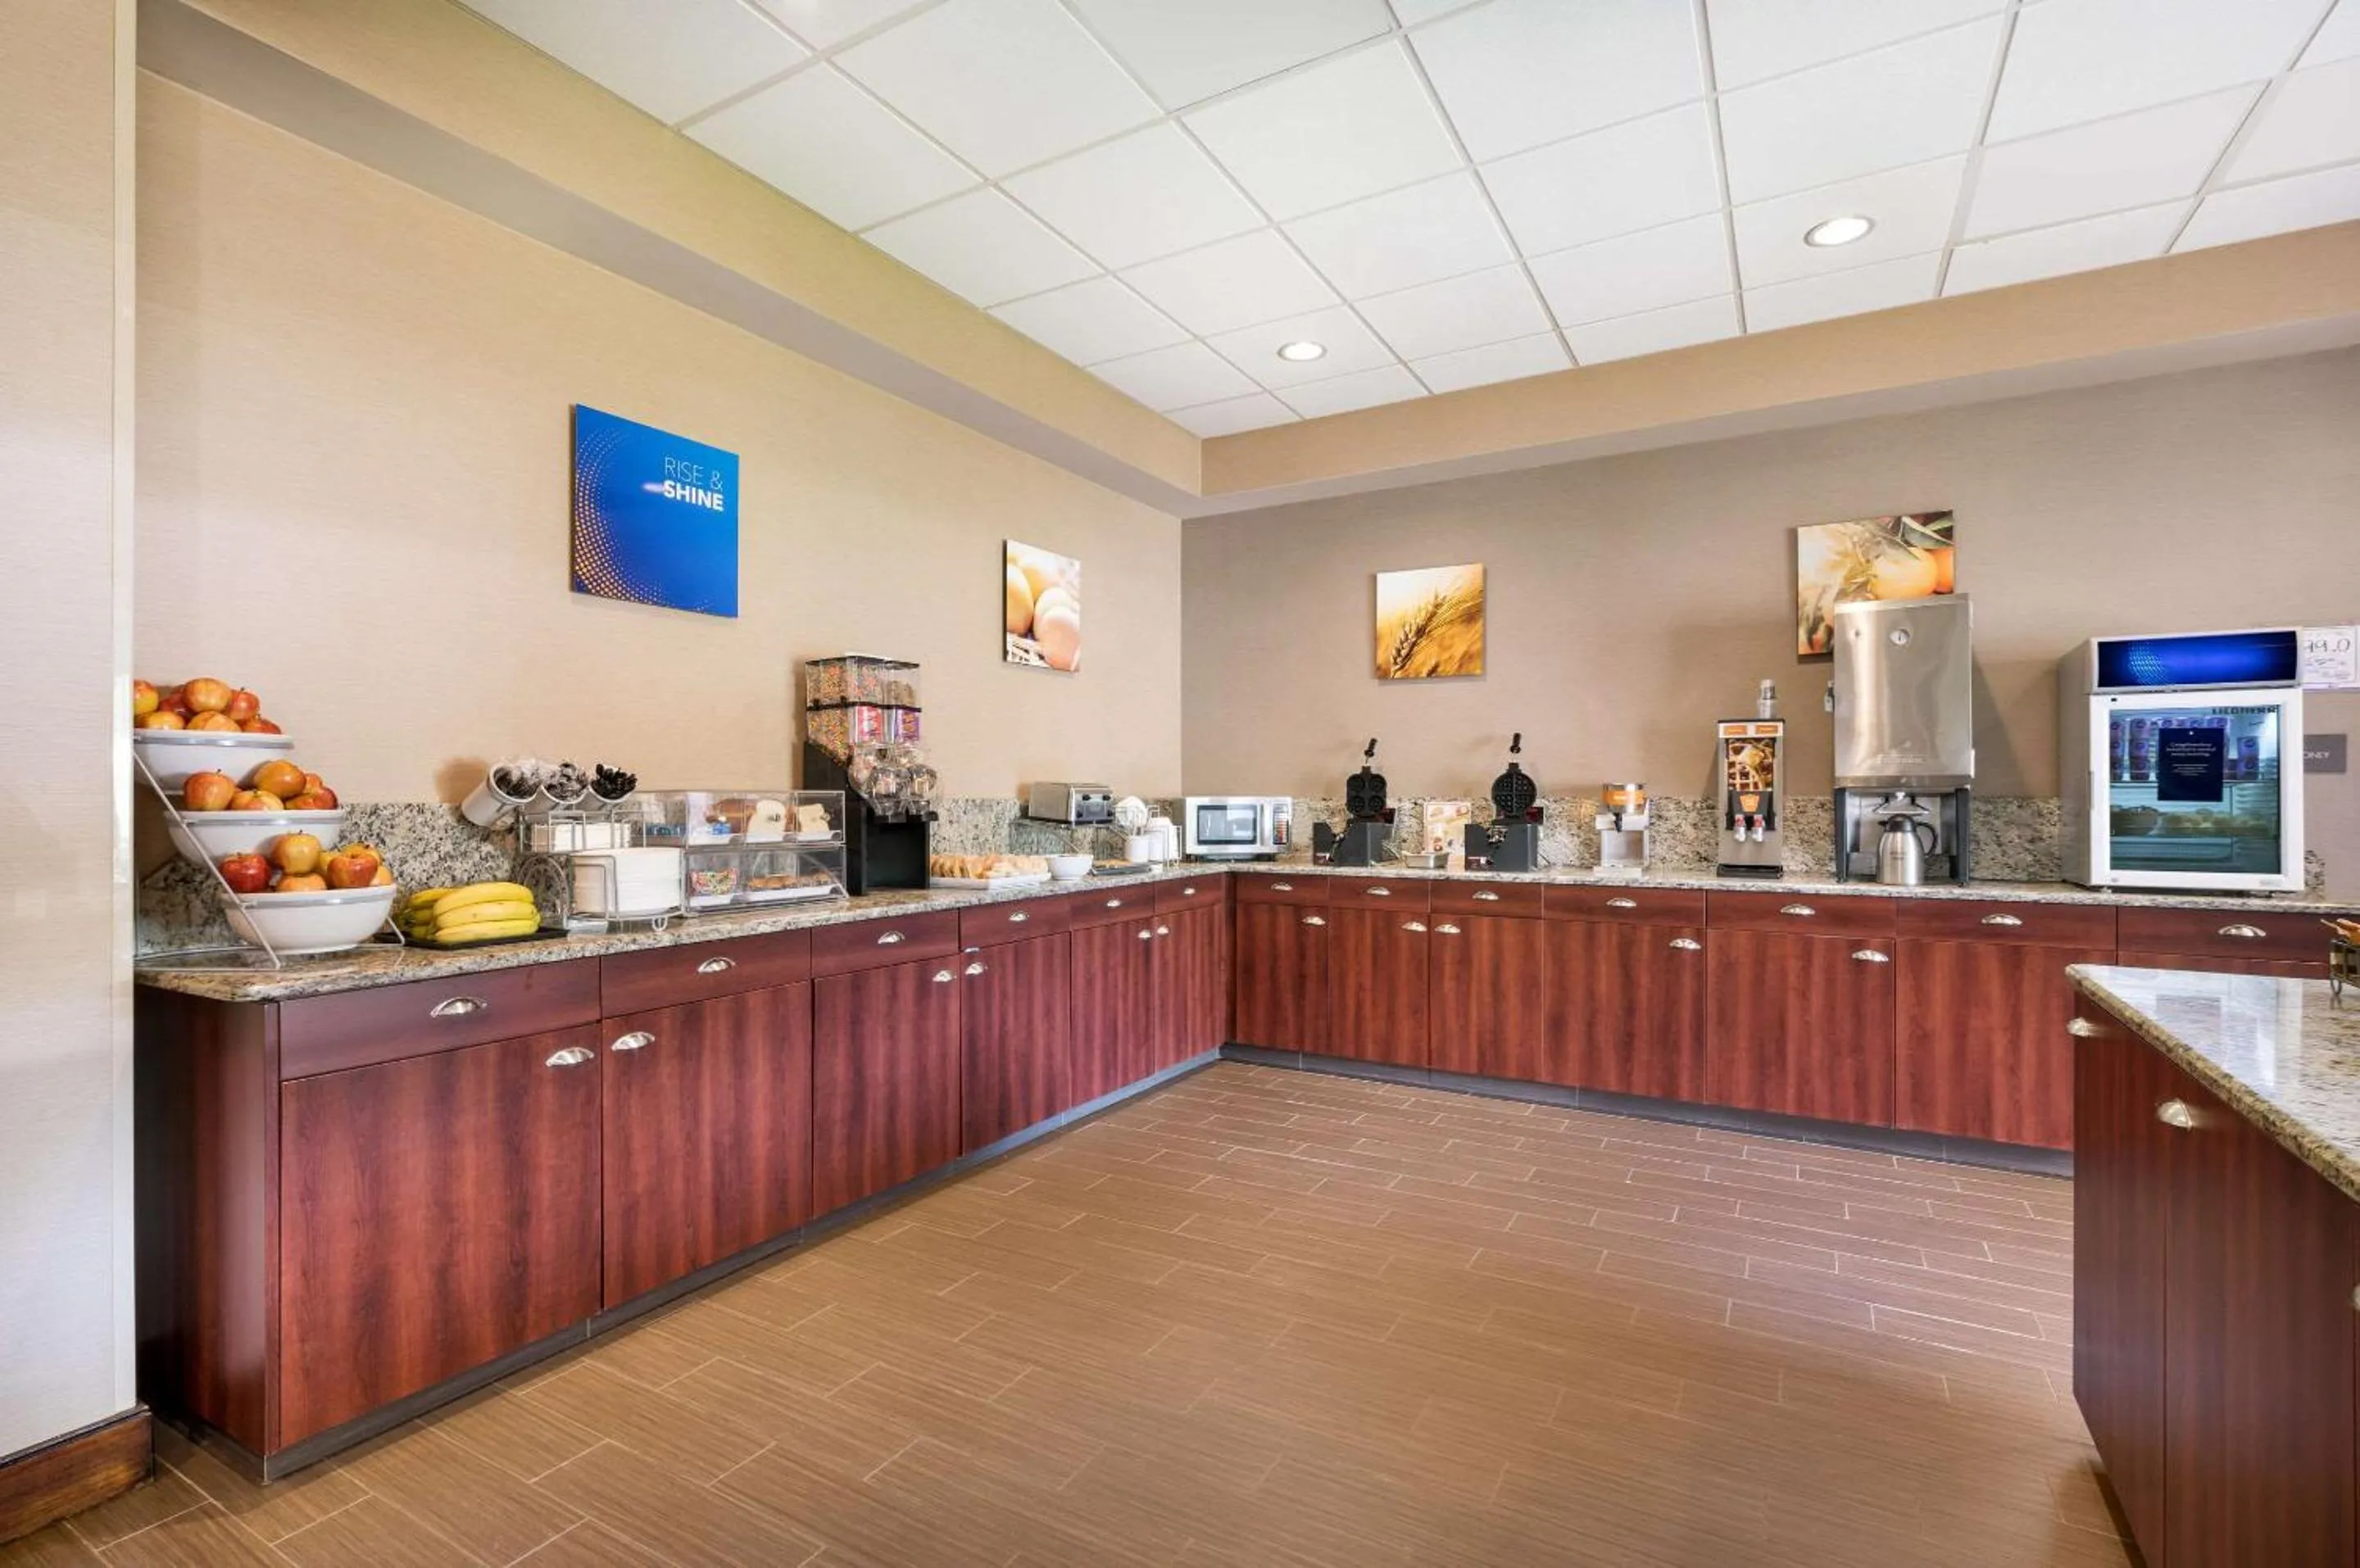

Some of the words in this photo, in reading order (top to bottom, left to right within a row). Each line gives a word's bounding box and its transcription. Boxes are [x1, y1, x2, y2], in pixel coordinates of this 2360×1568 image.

[665, 456, 704, 485] RISE
[710, 469, 723, 492] &
[663, 479, 724, 512] SHINE
